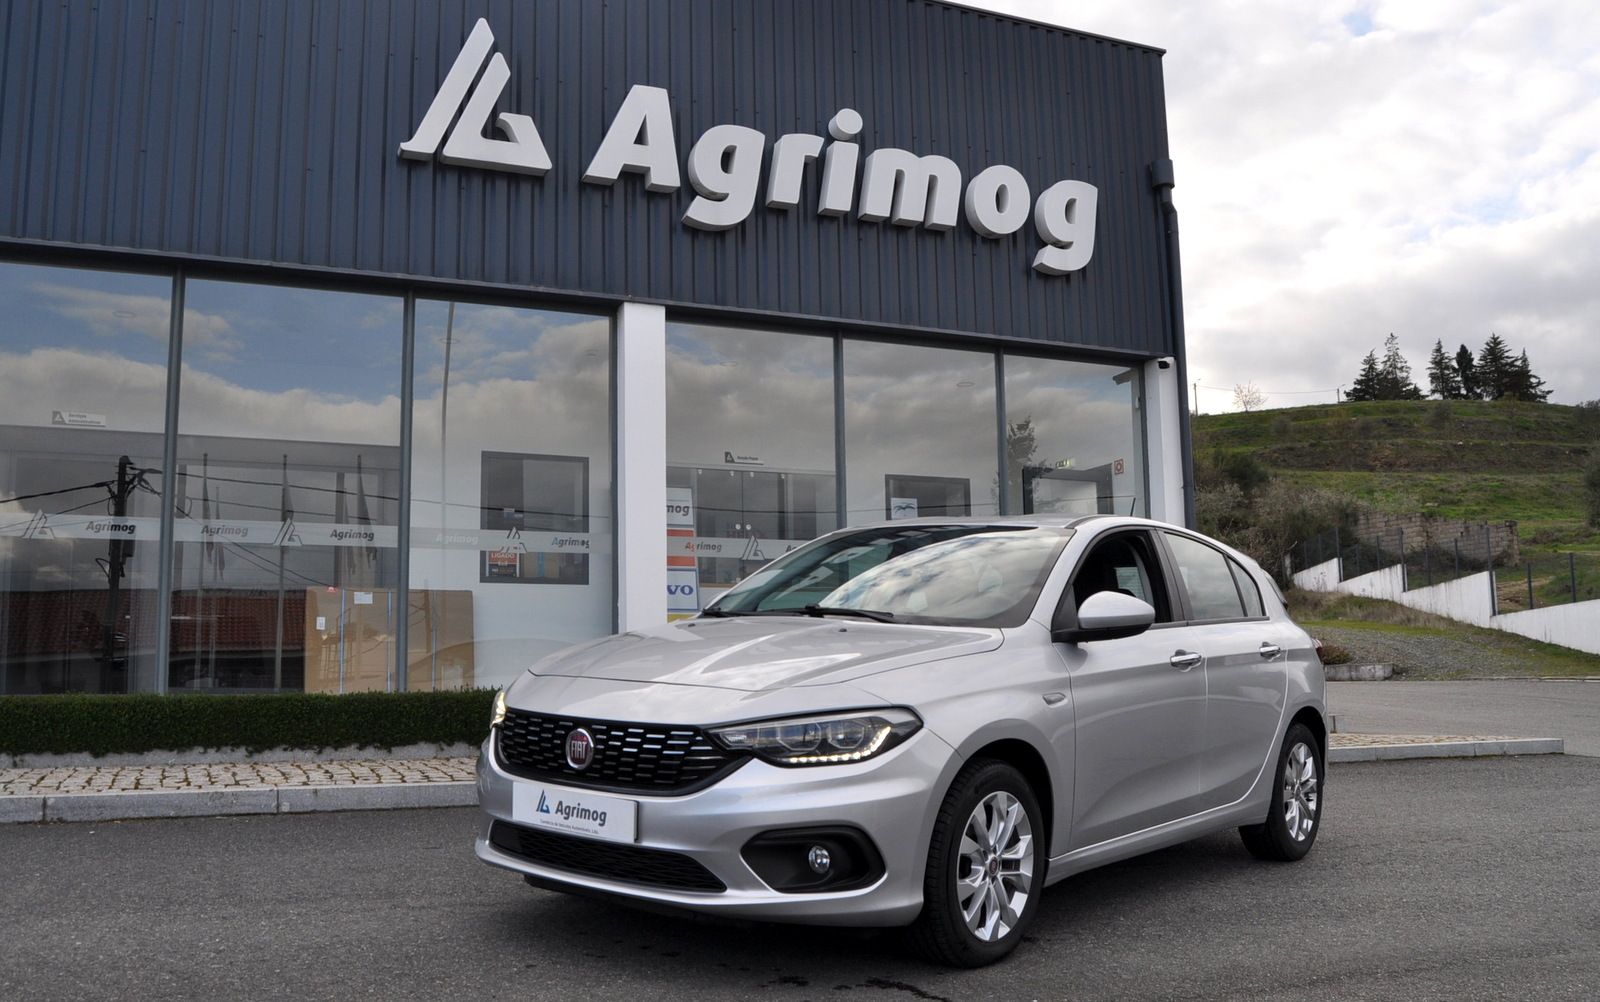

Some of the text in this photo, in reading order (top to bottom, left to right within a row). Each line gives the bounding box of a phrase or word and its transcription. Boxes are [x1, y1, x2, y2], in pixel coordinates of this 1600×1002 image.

[582, 84, 1099, 276] Agrimog
[86, 521, 136, 535] Agrimog
[201, 524, 249, 537] Agrimog
[329, 529, 375, 542] Agrimog
[436, 533, 479, 545] Agrimog
[685, 541, 722, 553] Agrimog
[571, 741, 587, 759] FIAT
[555, 801, 607, 827] Agrimog
